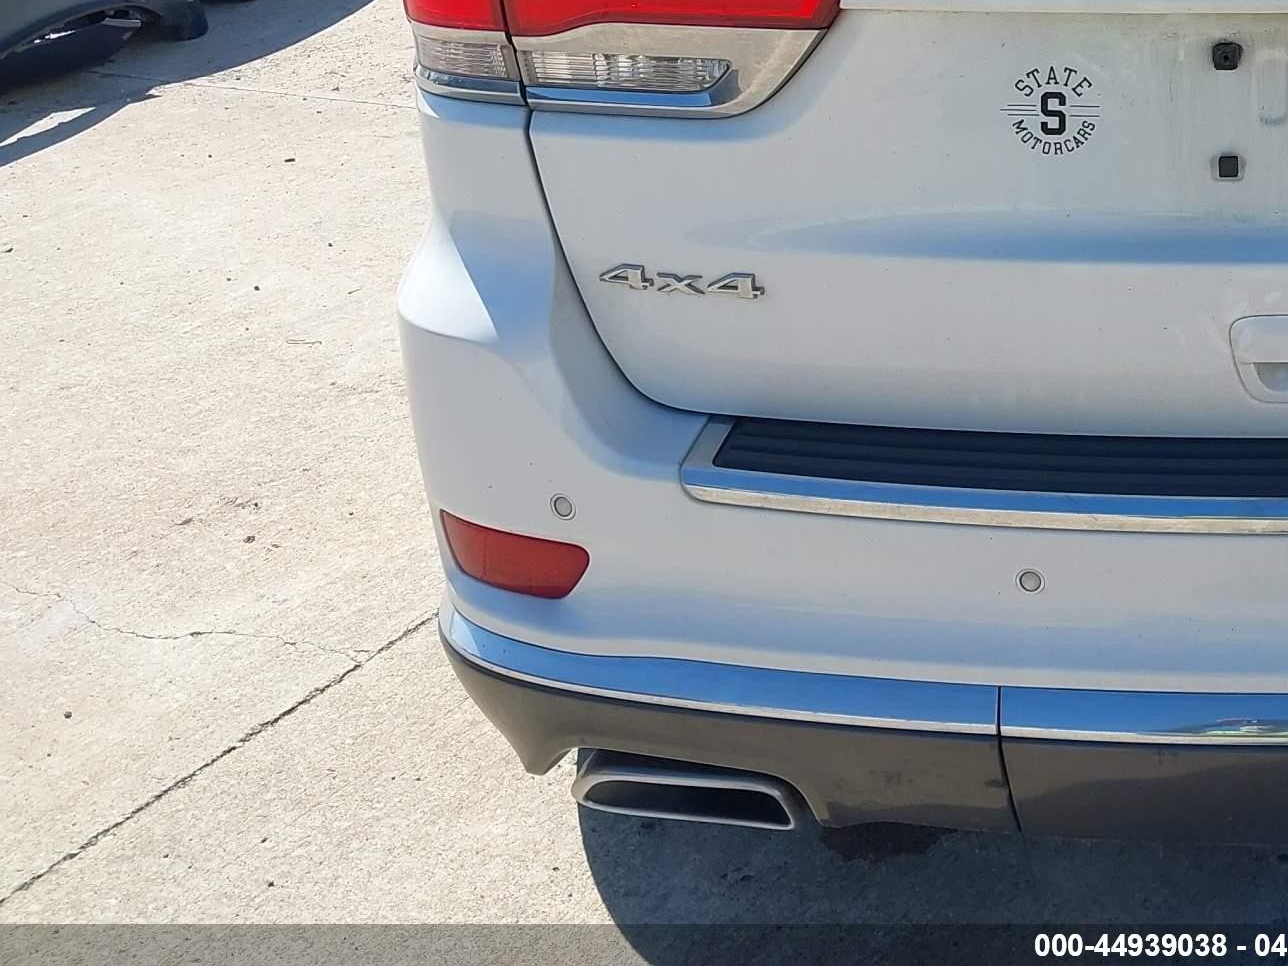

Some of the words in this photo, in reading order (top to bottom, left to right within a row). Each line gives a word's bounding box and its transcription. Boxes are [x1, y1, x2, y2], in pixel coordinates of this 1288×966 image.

[1014, 66, 1093, 97] STATE
[1040, 91, 1067, 136] S
[1012, 119, 1096, 155] MOTORCARS
[599, 263, 766, 300] 4x4
